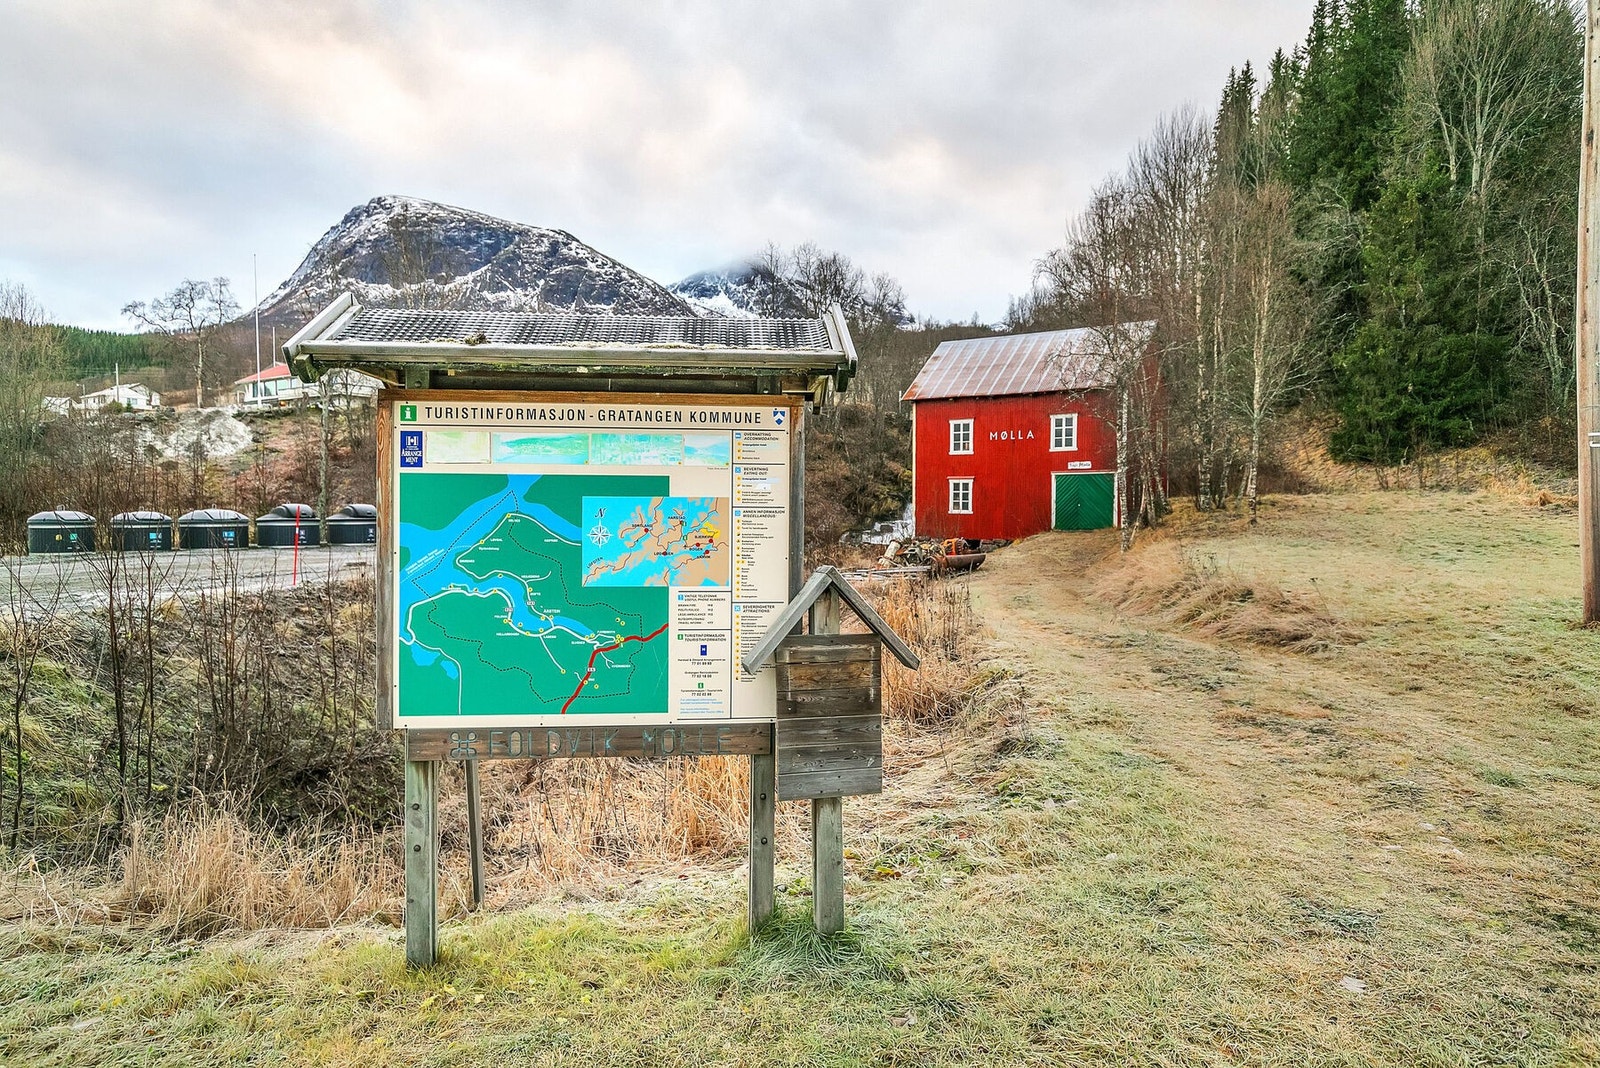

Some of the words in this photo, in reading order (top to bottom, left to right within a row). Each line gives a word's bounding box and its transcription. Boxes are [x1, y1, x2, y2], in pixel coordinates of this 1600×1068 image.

[425, 406, 586, 421] TURISTINFORMASJON
[598, 409, 682, 423] GRATANGEN
[689, 411, 761, 424] KOMMUNE
[989, 430, 1034, 440] MØLLA
[489, 728, 618, 757] FOLDVIK
